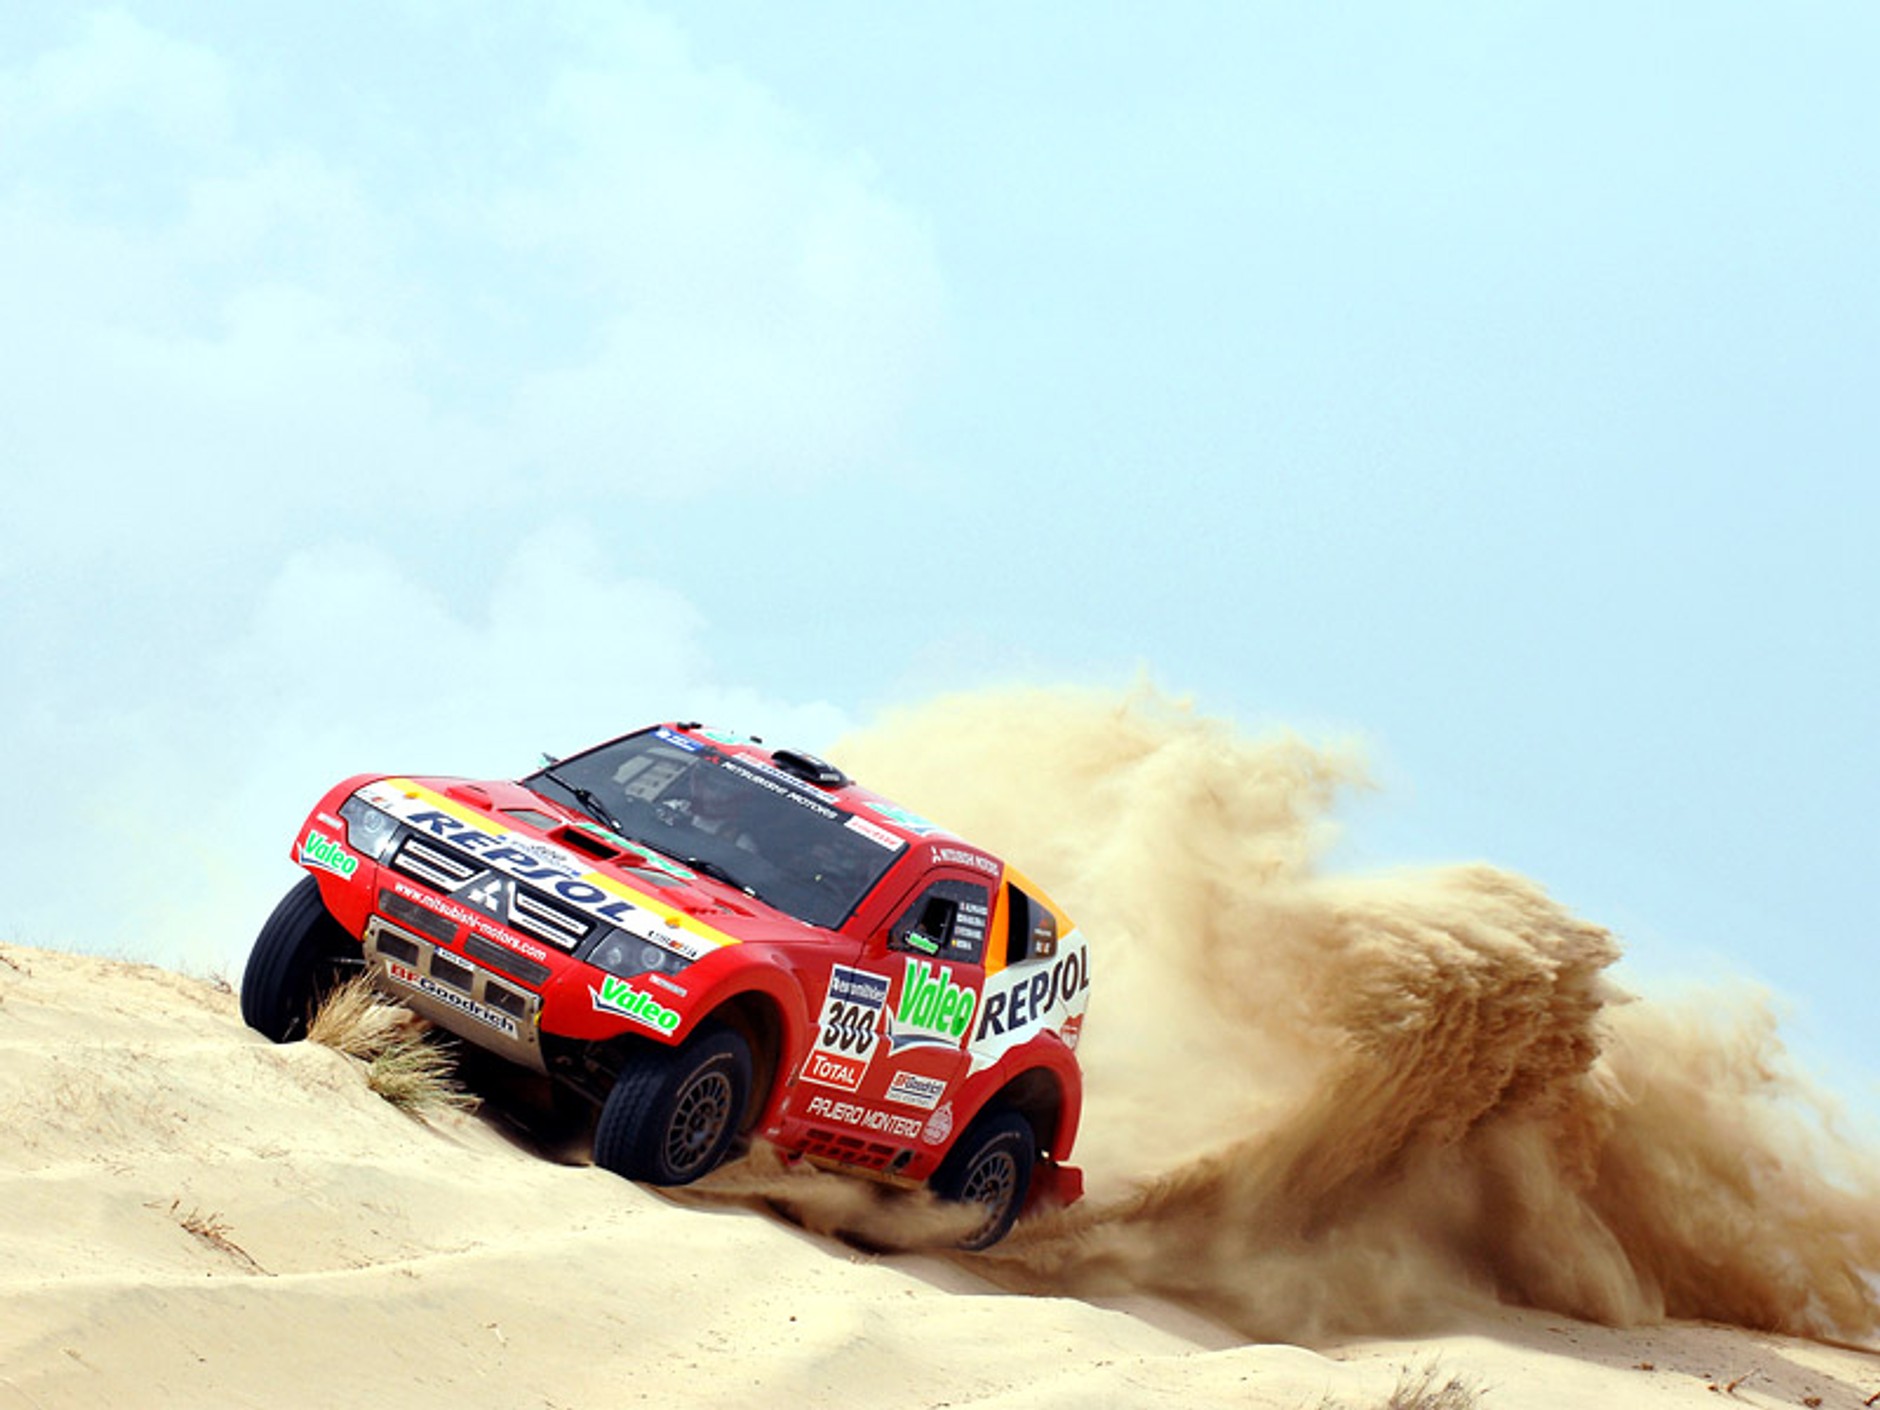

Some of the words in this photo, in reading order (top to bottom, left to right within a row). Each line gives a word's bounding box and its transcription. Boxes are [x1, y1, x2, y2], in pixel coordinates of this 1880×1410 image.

[787, 791, 839, 819] MOTORS
[304, 831, 358, 875] Valeo
[405, 811, 636, 922] REPSOL
[395, 882, 547, 961] www.mitsubishi-motors.com
[390, 963, 514, 1033] BFGoodrich
[601, 976, 679, 1030] Valeo
[899, 962, 975, 1037] Valeo
[975, 945, 1089, 1042] REPSOL
[823, 1001, 875, 1054] 300
[812, 1055, 855, 1084] TOTAL
[806, 1097, 864, 1125] PAJERO
[861, 1109, 923, 1139] MONTERO
